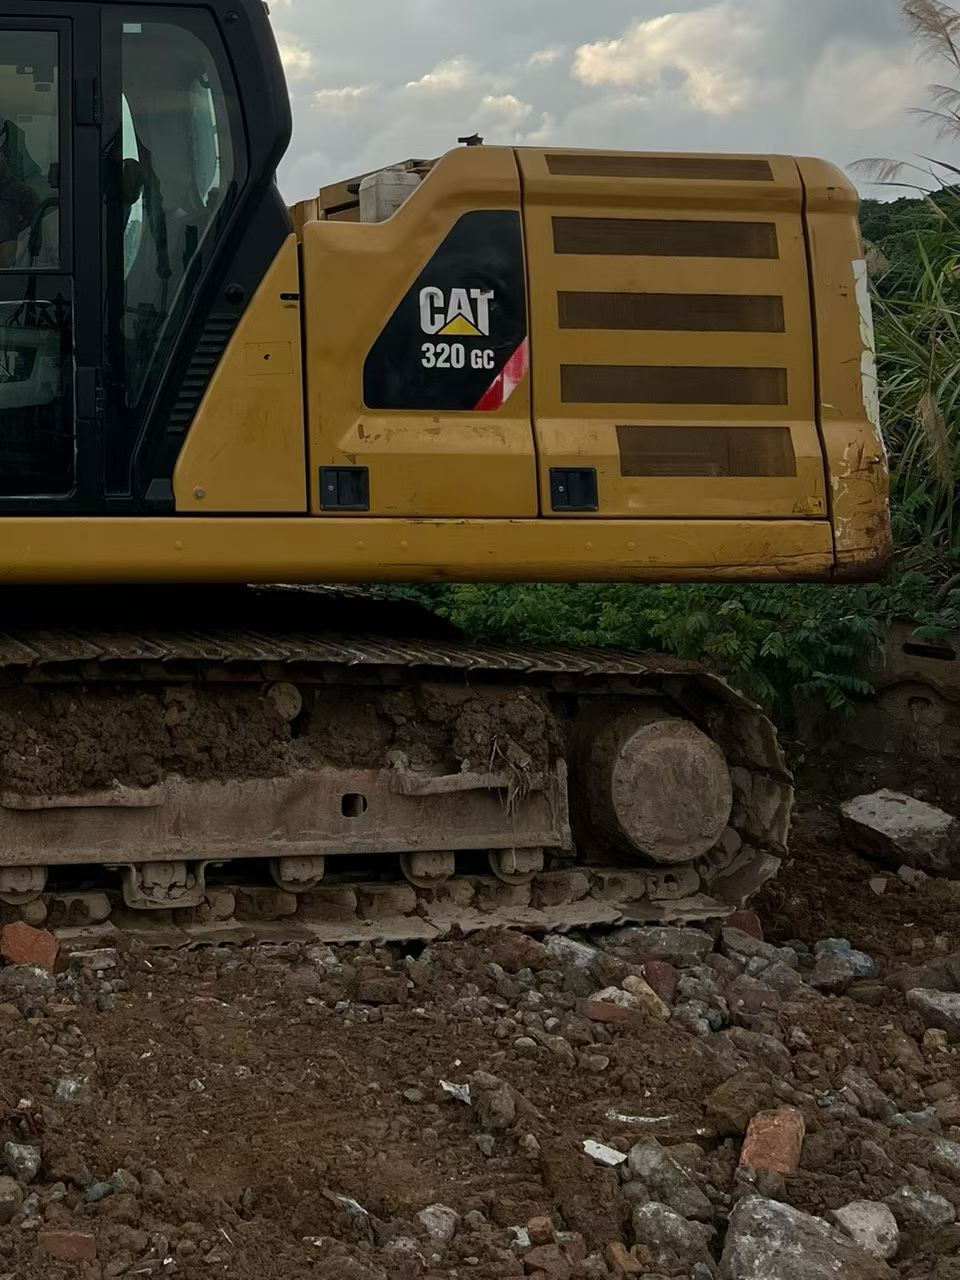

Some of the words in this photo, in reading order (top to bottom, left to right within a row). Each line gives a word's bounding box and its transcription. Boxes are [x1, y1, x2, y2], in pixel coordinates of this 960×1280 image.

[419, 286, 495, 336] CAT
[421, 342, 465, 369] 320
[470, 349, 495, 369] GC
